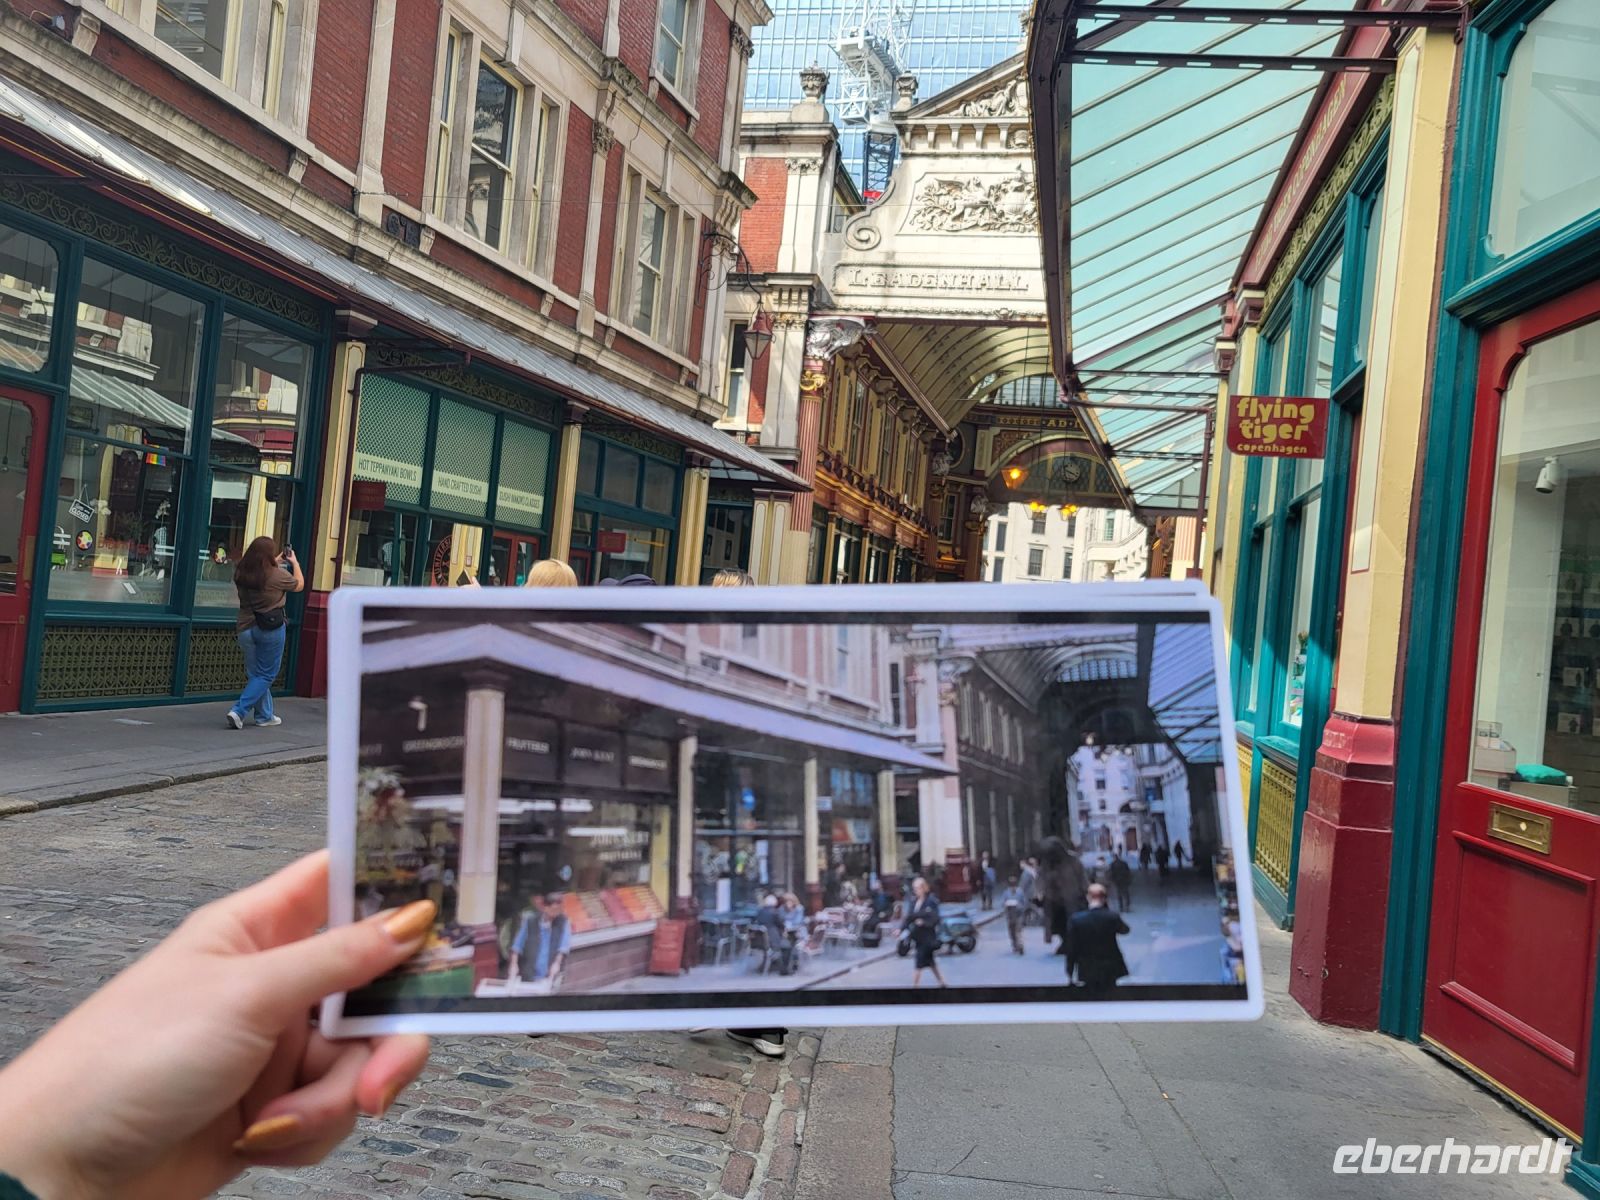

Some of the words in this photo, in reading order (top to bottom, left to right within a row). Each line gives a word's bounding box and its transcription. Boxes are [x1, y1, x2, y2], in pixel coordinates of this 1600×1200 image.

[847, 268, 1030, 292] LEADENHALL
[1236, 397, 1315, 424] flying
[1239, 418, 1309, 444] tiger
[1236, 443, 1308, 455] copenhagen
[358, 459, 370, 471] HOT
[370, 461, 399, 478] TEPPANYAKI
[399, 468, 418, 482] BOWLS
[438, 476, 450, 489] HAND
[450, 478, 469, 493] CRAFTED
[469, 483, 482, 496] SUSHI
[71, 507, 89, 521] CLOSED
